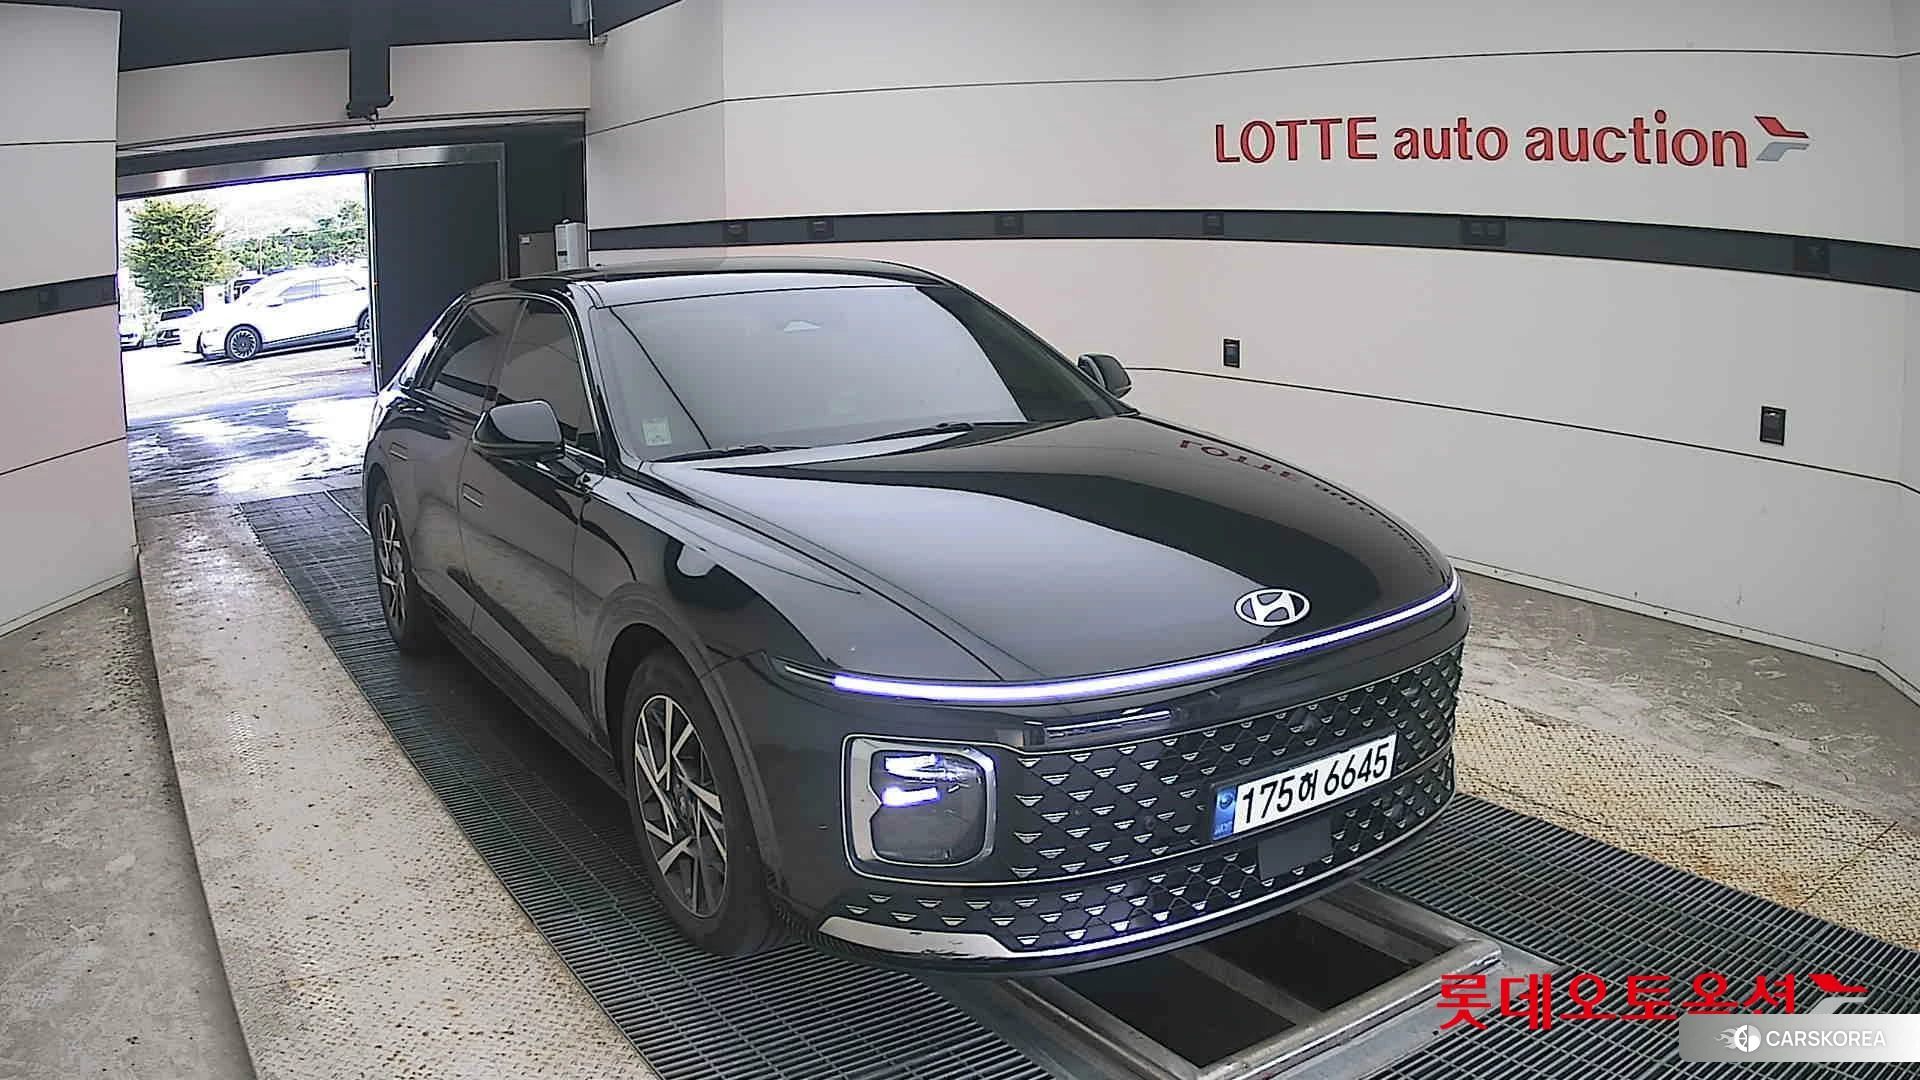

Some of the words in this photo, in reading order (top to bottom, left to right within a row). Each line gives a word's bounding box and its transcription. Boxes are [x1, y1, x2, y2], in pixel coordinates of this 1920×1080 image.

[1215, 115, 1377, 163] LOTTE
[1394, 117, 1510, 162] auto
[1525, 109, 1749, 168] auction
[1324, 743, 1390, 796] 6645
